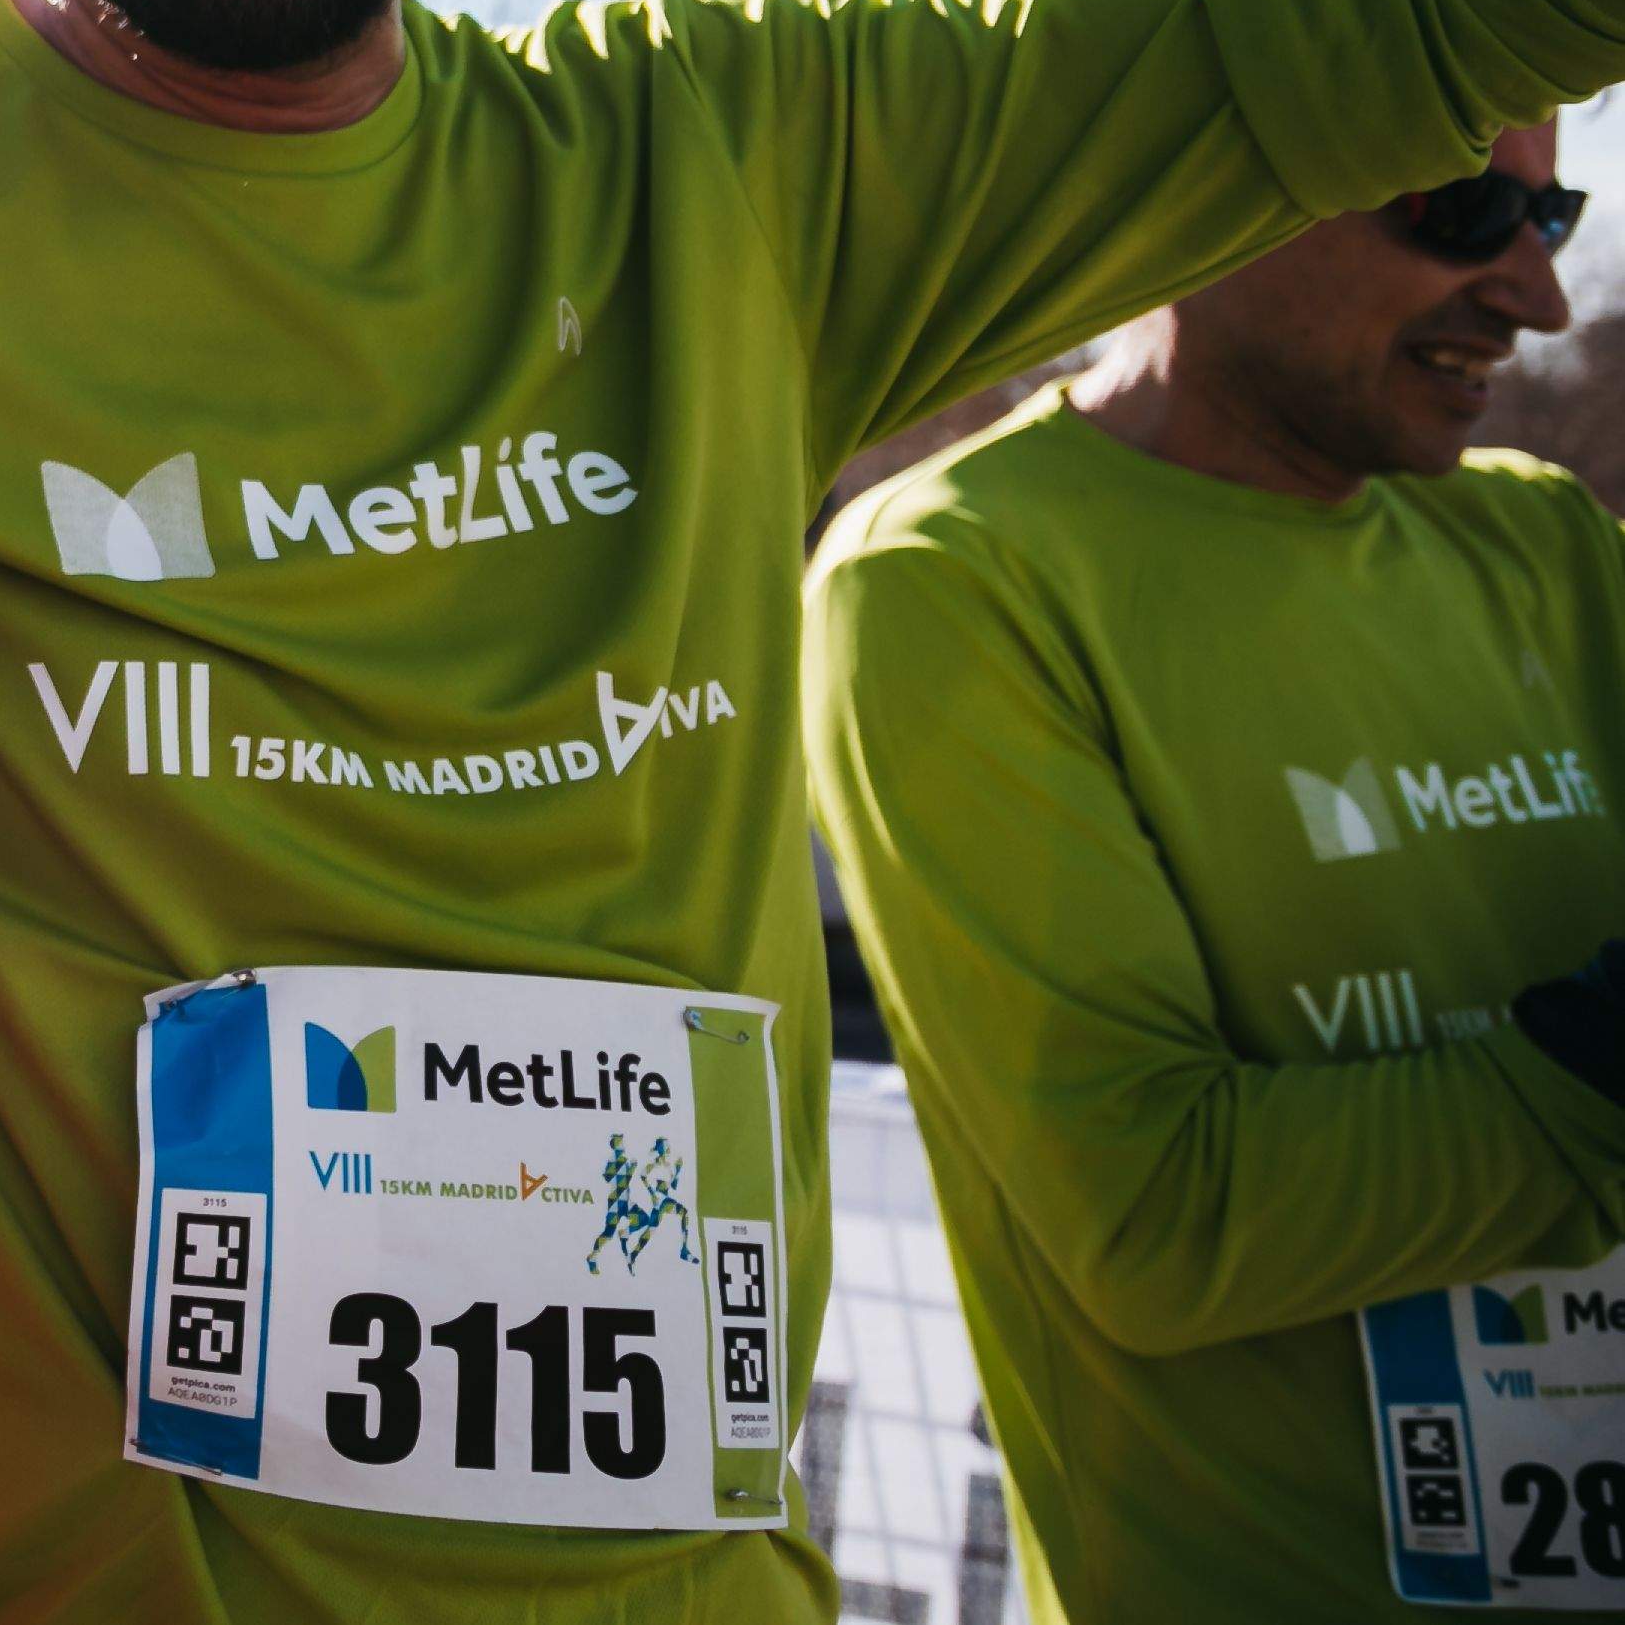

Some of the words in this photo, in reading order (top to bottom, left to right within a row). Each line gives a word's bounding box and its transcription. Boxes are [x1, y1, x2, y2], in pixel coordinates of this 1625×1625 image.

[241, 430, 639, 561] MetLife
[27, 660, 211, 778] VIII
[230, 734, 374, 789] 15KM
[384, 738, 599, 796] MADRID
[1293, 968, 1425, 1055] VIII
[423, 1042, 672, 1117] MetLife
[203, 1197, 228, 1208] 3115
[309, 1150, 373, 1195] VIII
[380, 1179, 433, 1197] 15KM
[439, 1181, 518, 1201] MADRID
[520, 1161, 595, 1205] ACTIVA
[171, 1377, 236, 1393] getpica.com
[325, 1292, 667, 1481] 3115
